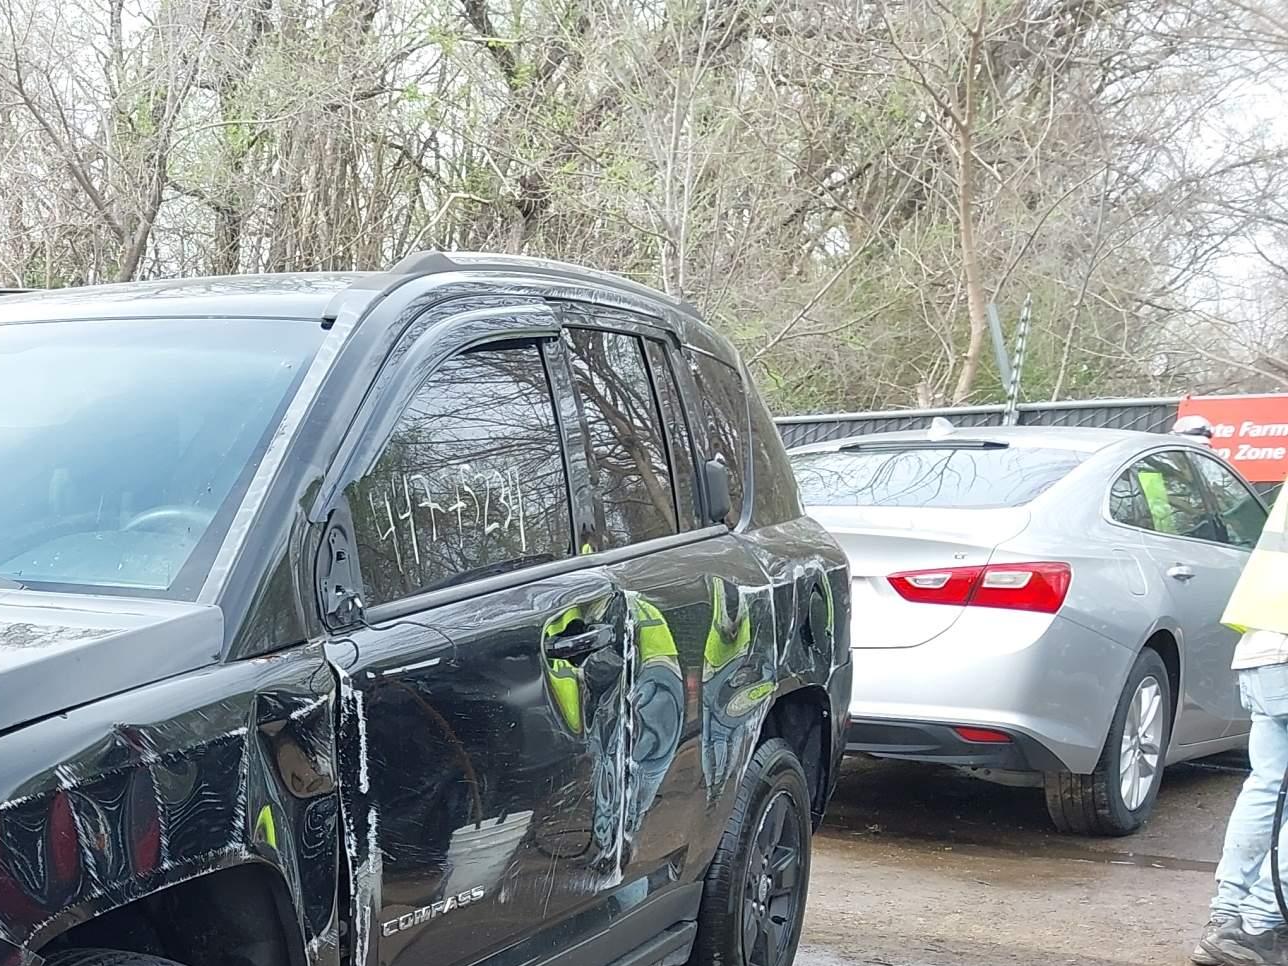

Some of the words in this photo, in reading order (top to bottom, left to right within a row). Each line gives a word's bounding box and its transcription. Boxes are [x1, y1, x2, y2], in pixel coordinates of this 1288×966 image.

[1240, 421, 1288, 437] Farm
[1235, 444, 1287, 460] Zone
[382, 885, 485, 937] COMPASS
